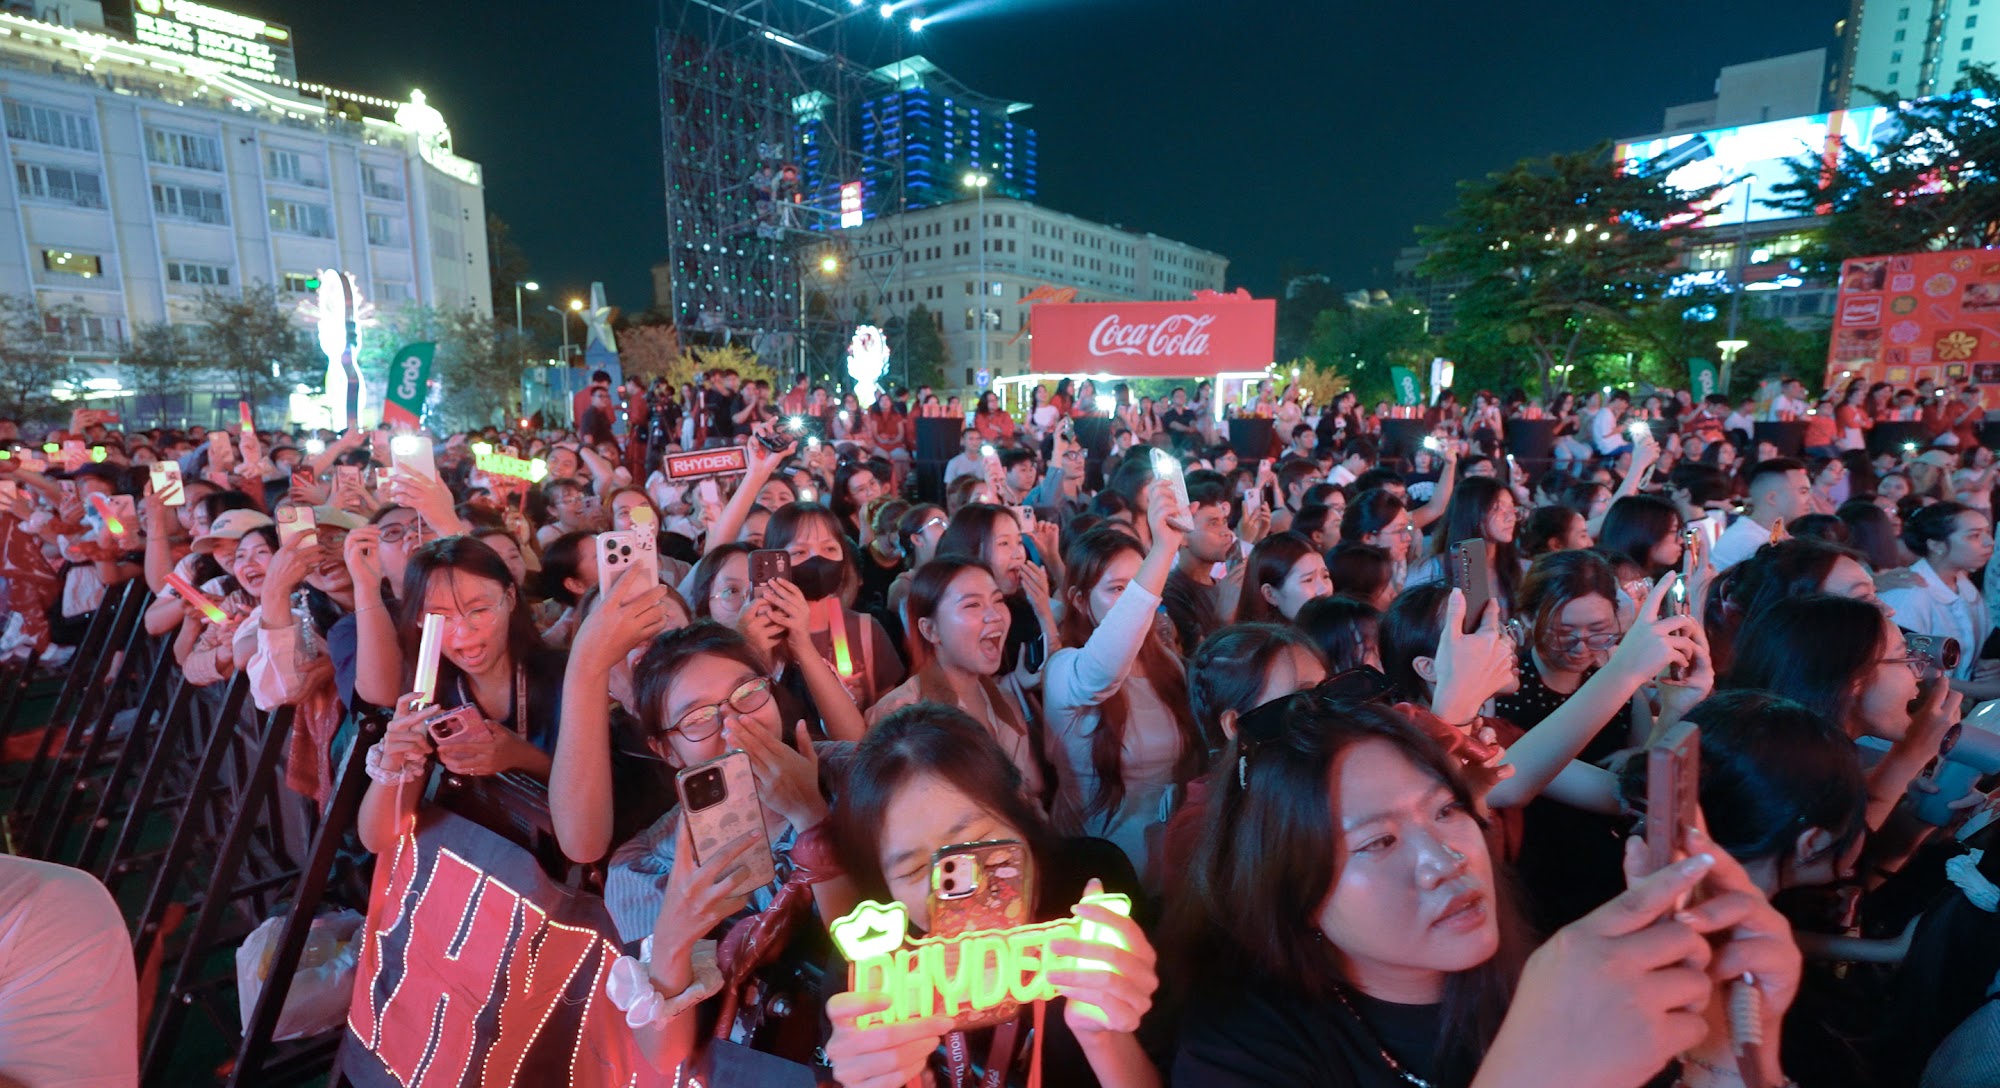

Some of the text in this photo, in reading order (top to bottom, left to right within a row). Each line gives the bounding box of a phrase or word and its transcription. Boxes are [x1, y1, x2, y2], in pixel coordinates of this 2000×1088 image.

[1088, 314, 1216, 356] Coca-Cola
[398, 356, 422, 399] Grab
[673, 455, 732, 472] RHYDER
[950, 1032, 963, 1062] ROUD
